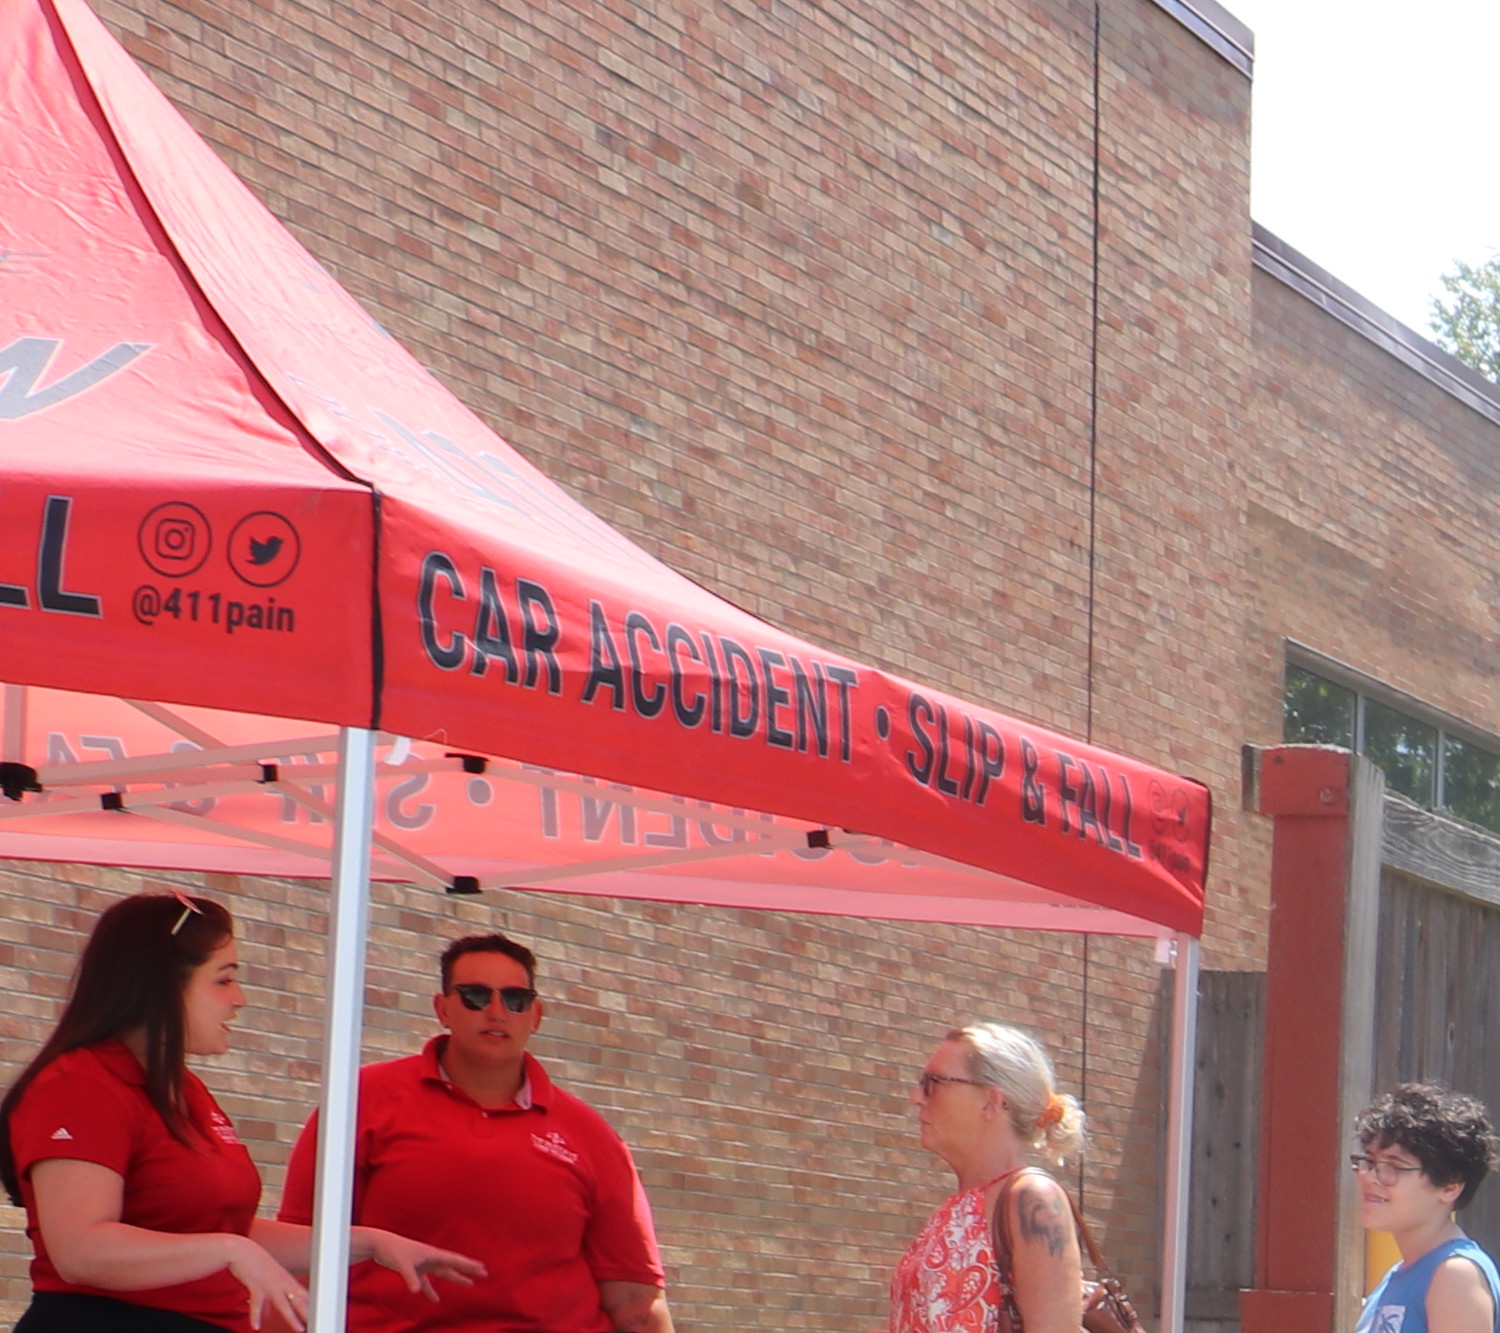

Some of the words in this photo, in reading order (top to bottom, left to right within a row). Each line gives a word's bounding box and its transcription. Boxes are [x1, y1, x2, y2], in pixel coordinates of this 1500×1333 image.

[132, 584, 296, 634] @411pain
[417, 550, 564, 698] CAR
[580, 599, 860, 764] ACCIDENT
[906, 691, 1006, 807] SLIP
[1019, 734, 1048, 828] &
[1056, 751, 1146, 862] FALL
